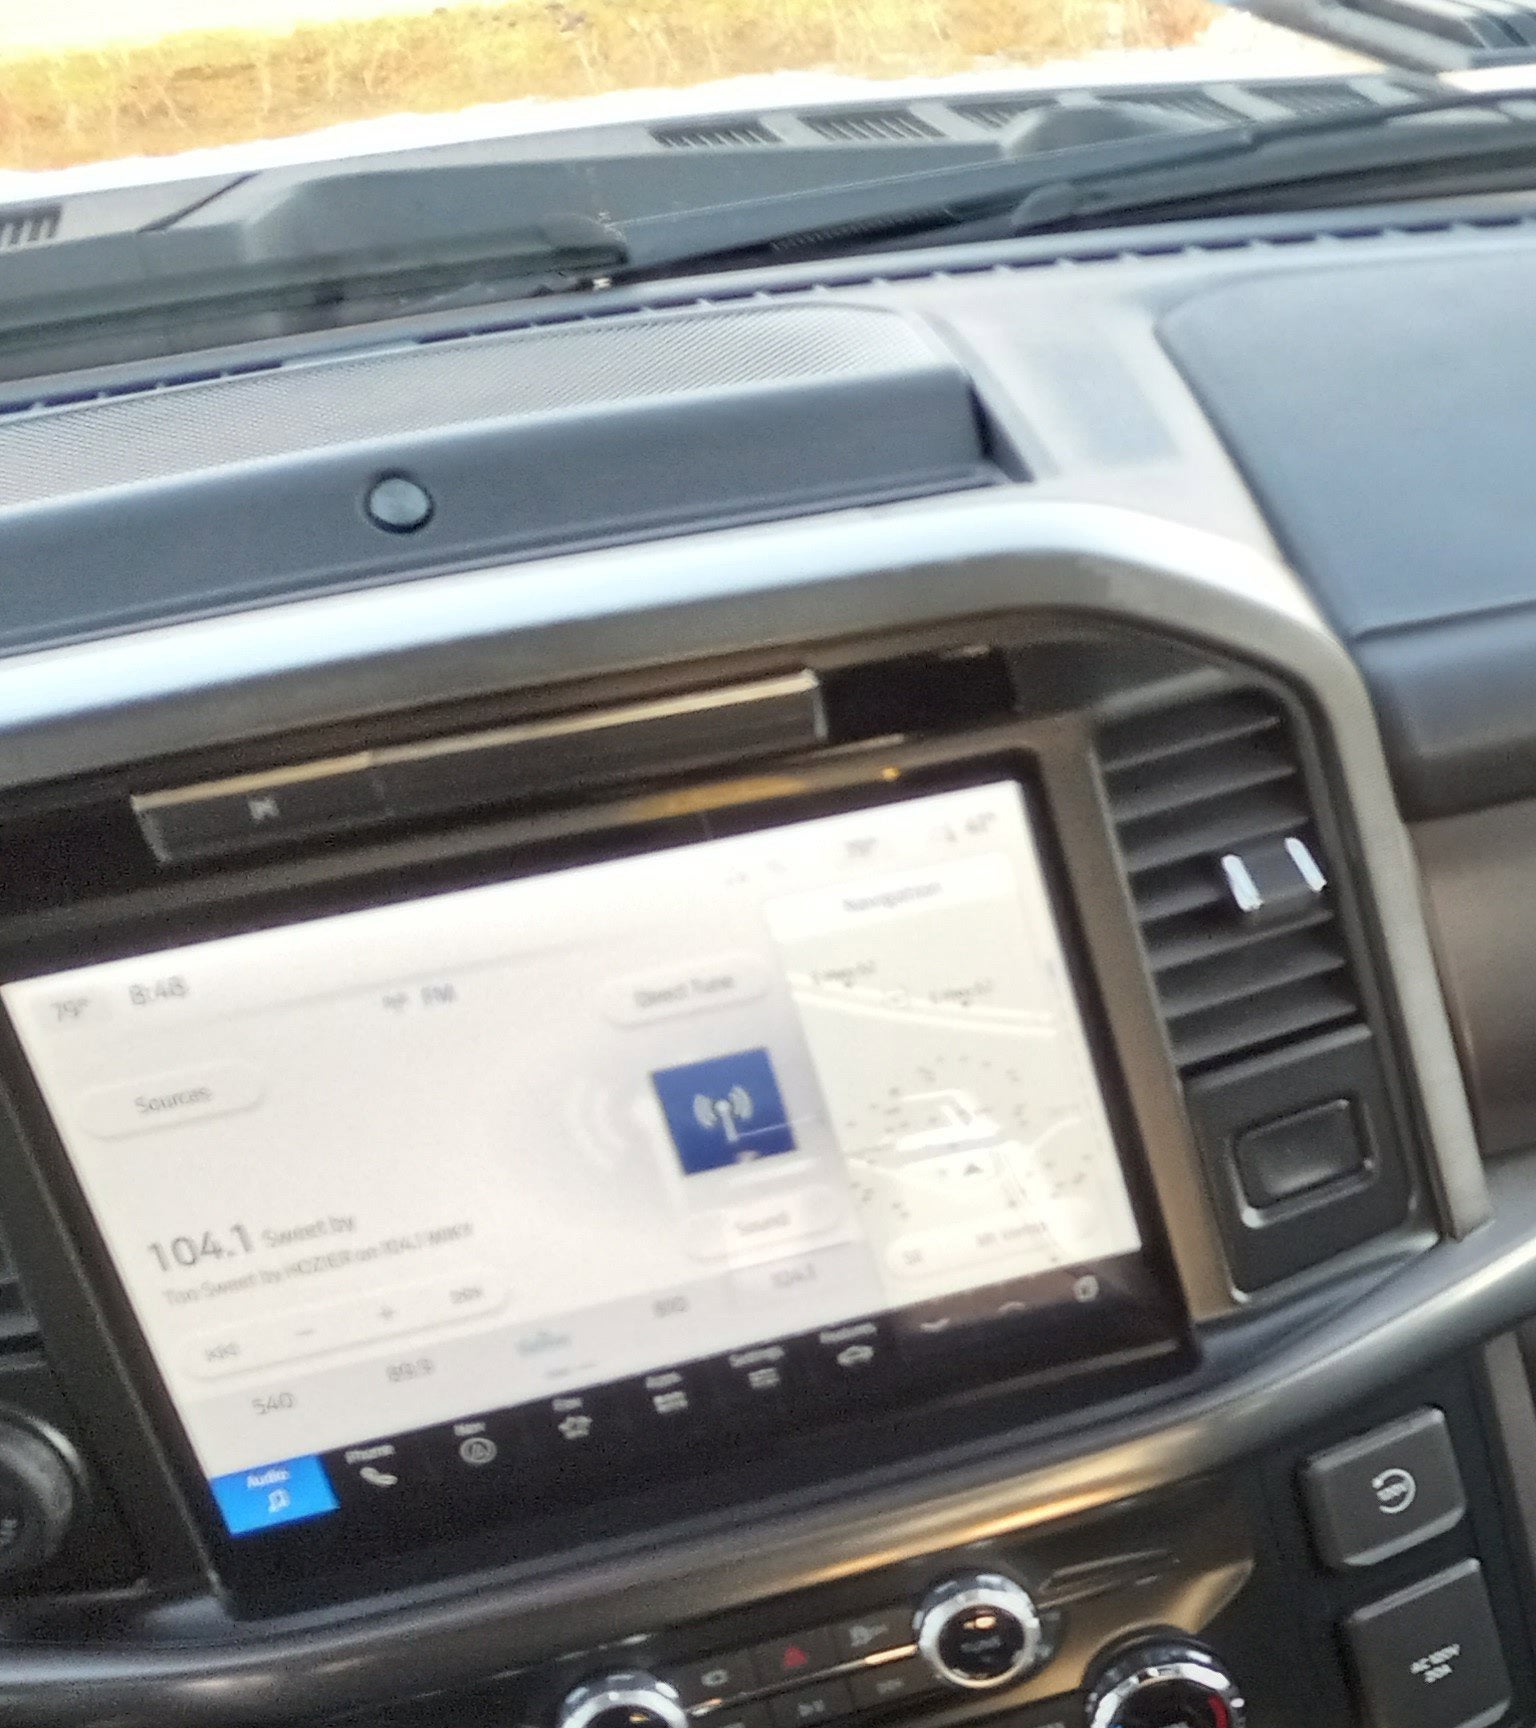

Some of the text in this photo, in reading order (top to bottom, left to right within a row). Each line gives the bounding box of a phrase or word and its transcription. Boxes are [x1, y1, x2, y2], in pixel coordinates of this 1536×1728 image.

[129, 976, 188, 1005] 8:48
[134, 1086, 212, 1113] Sources
[148, 1223, 255, 1272] 104.1
